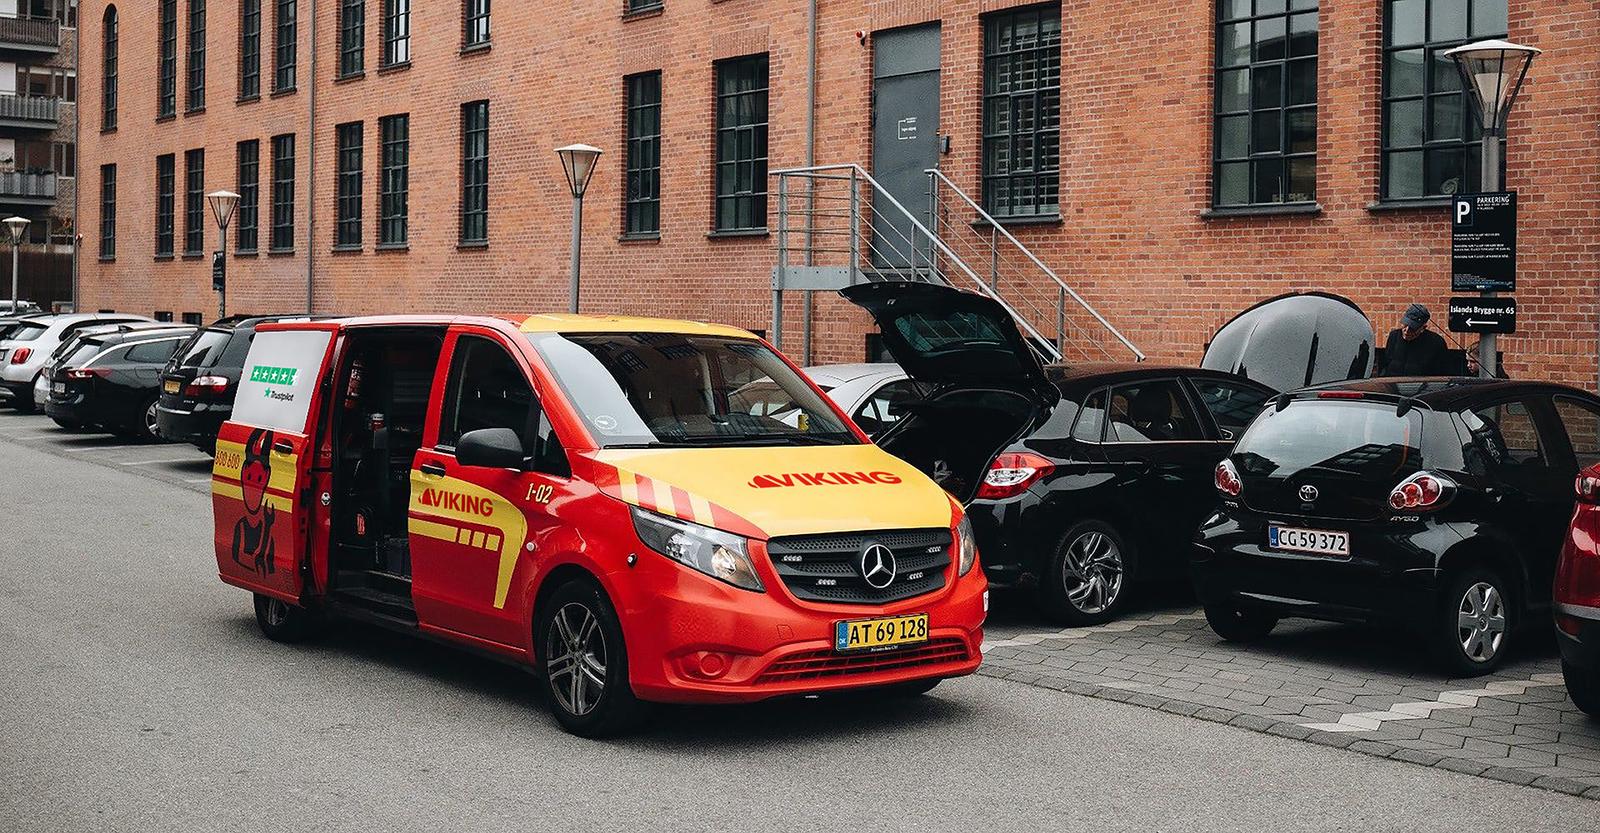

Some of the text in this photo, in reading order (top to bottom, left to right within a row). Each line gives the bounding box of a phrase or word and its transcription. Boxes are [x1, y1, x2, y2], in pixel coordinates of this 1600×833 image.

[1457, 201, 1471, 224] P
[1474, 306, 1495, 315] Brygge
[1505, 306, 1515, 315] 65
[271, 390, 294, 401] Trustpilot
[764, 471, 902, 487] VIKING
[430, 489, 494, 517] VIKING
[1279, 530, 1346, 551] CG 59 372
[850, 618, 925, 644] AT 69 128
